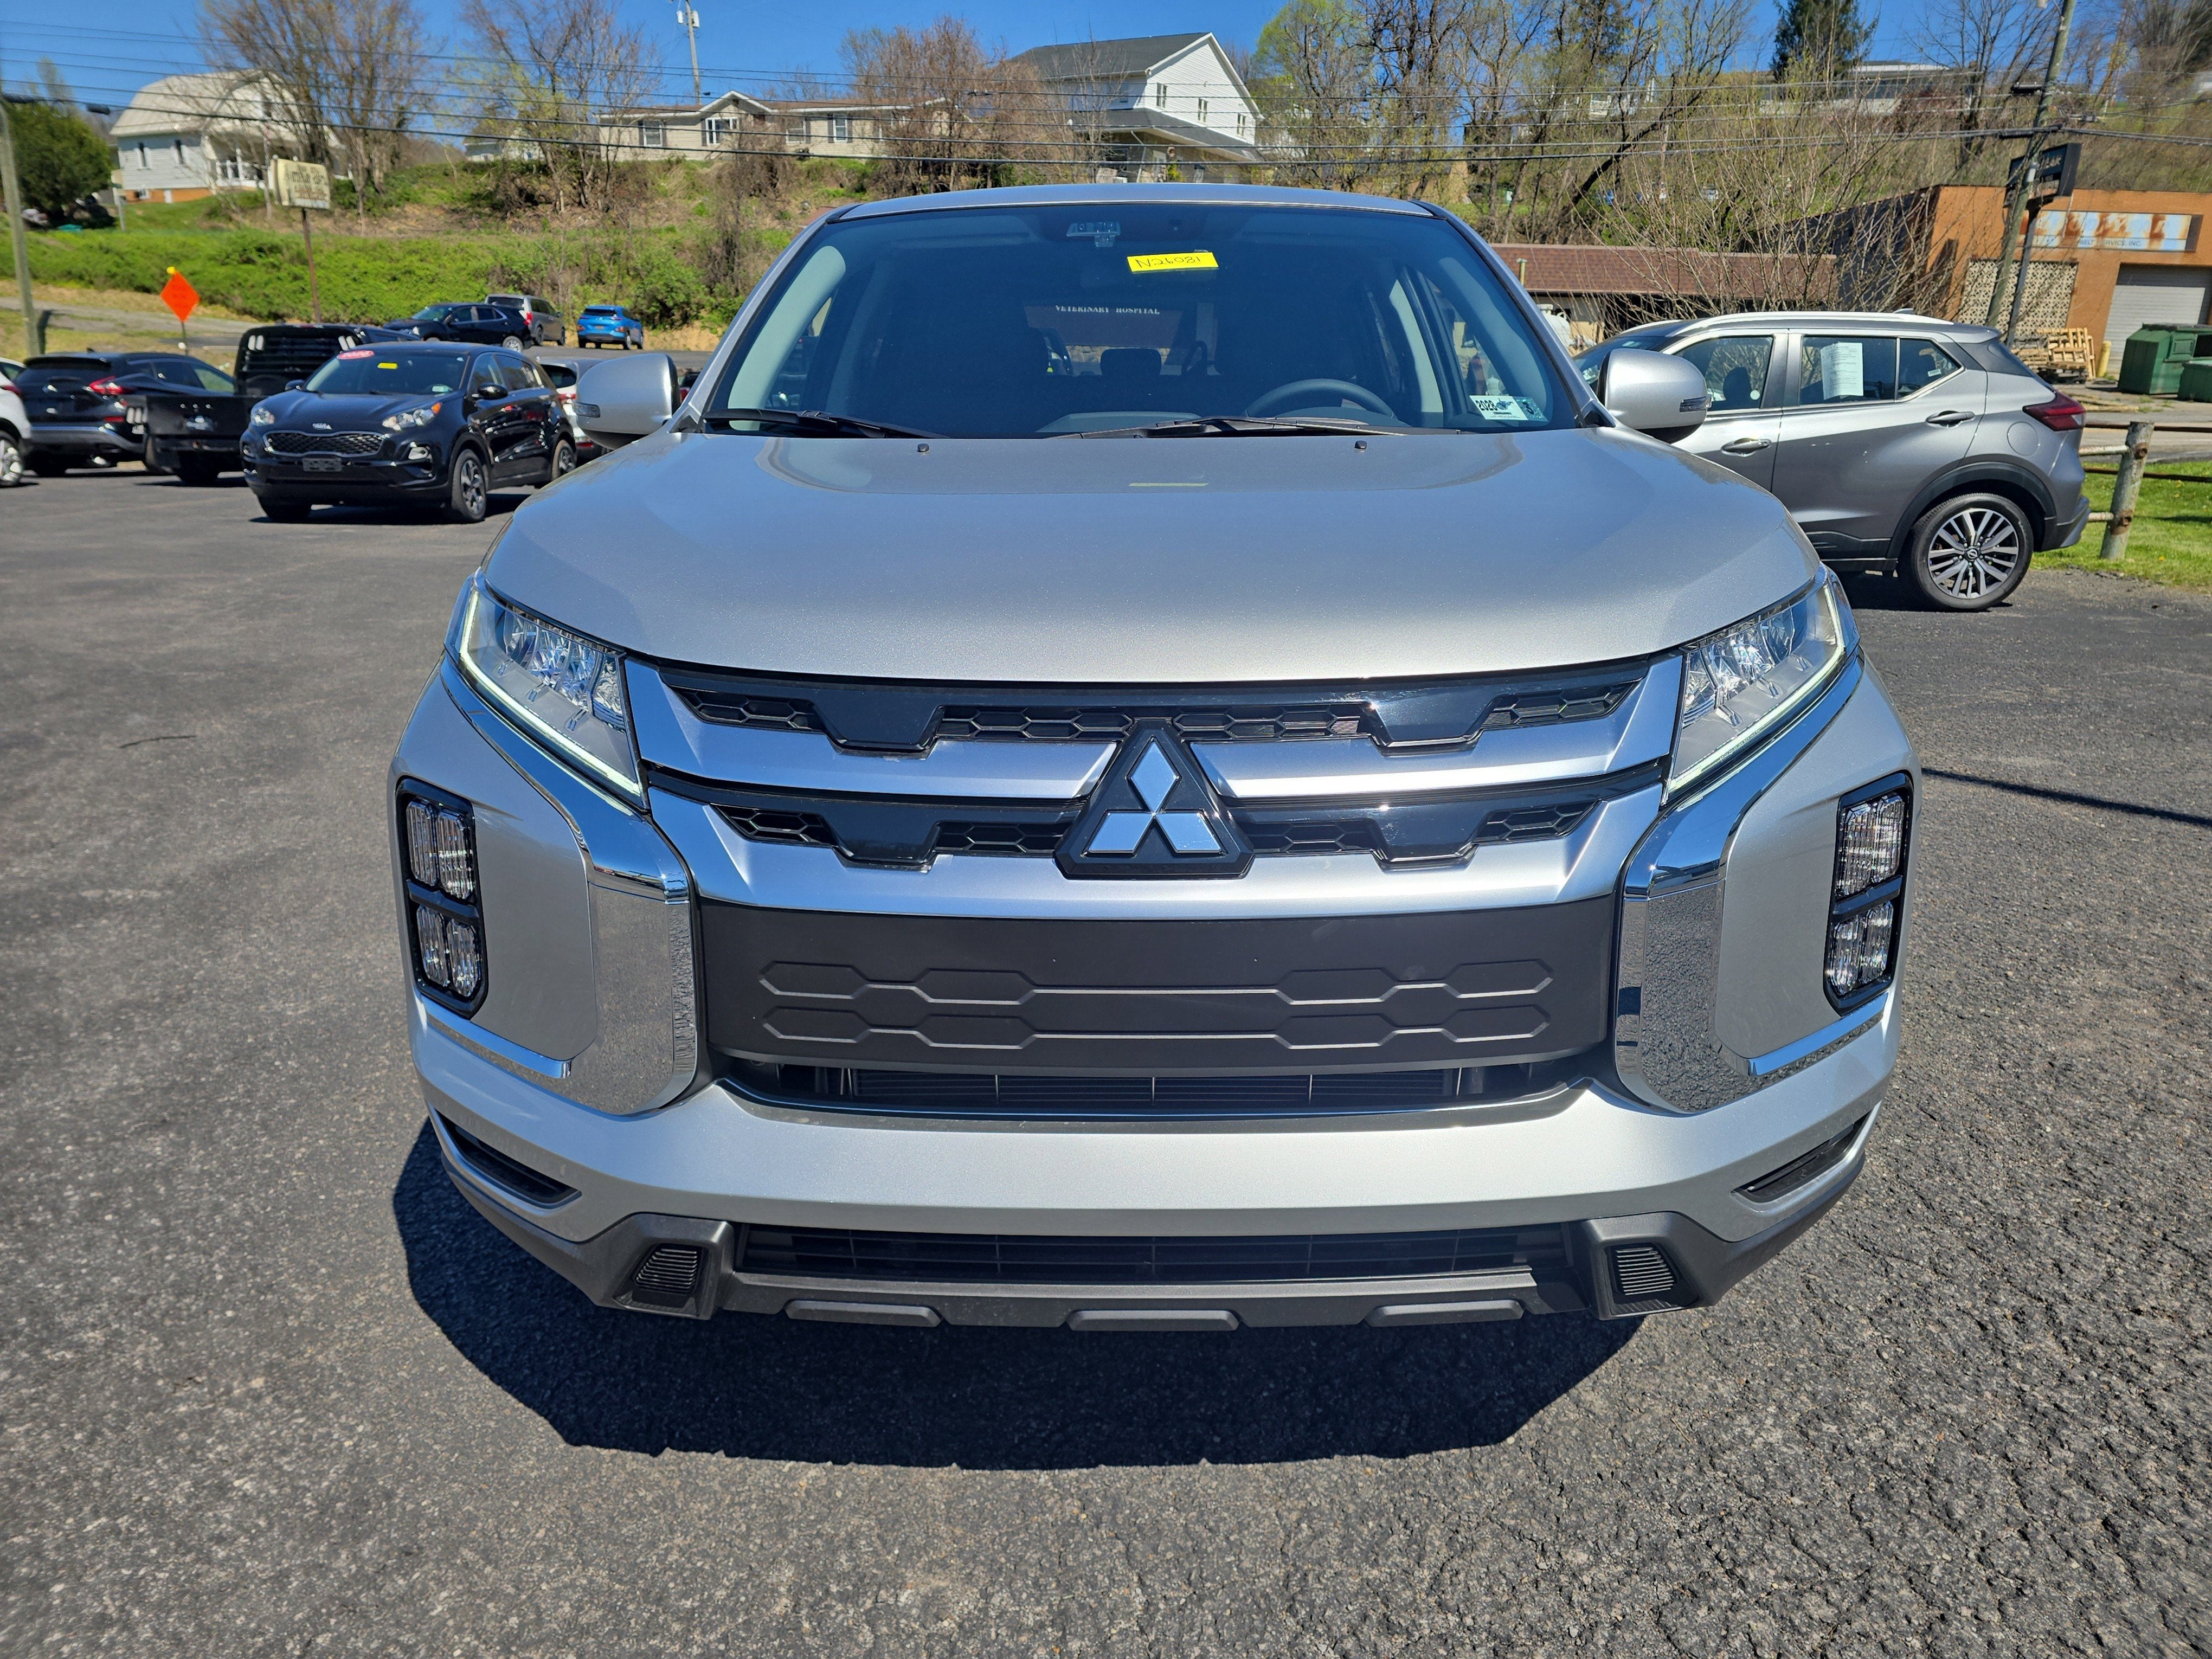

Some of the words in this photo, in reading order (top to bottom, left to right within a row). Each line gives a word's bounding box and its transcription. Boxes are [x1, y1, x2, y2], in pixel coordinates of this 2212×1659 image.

[1135, 256, 1201, 268] N26081
[1055, 305, 1109, 313] VETERINARY
[1116, 307, 1160, 315] HOSPITAL
[1475, 400, 1498, 411] 2028
